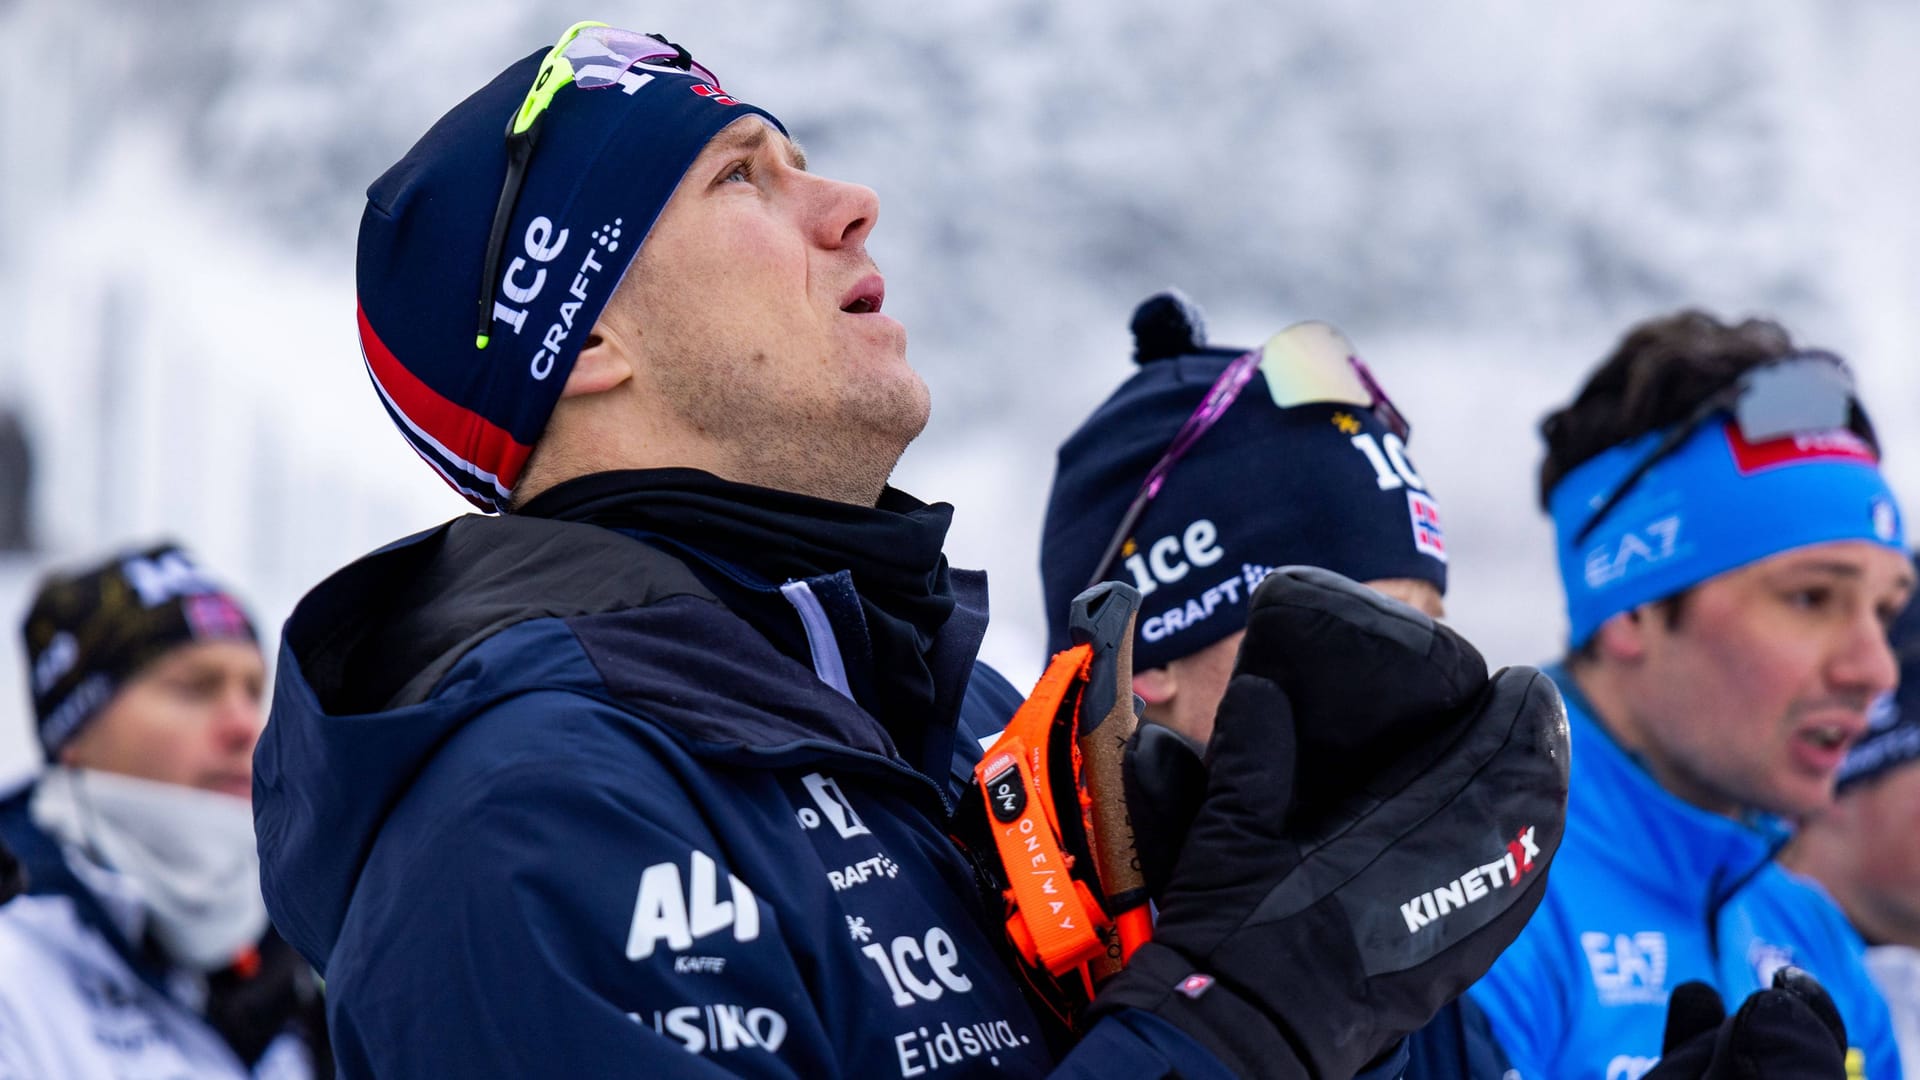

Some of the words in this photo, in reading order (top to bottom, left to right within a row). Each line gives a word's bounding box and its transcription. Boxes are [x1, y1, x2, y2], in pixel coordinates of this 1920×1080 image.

[492, 215, 570, 335] ice
[530, 248, 602, 381] CRAFT
[1125, 518, 1224, 596] ice
[1141, 576, 1242, 642] CRAFT
[626, 849, 760, 961] ALI
[826, 857, 884, 891] RAFT
[674, 956, 726, 974] KAFFE
[861, 926, 973, 1007] ice
